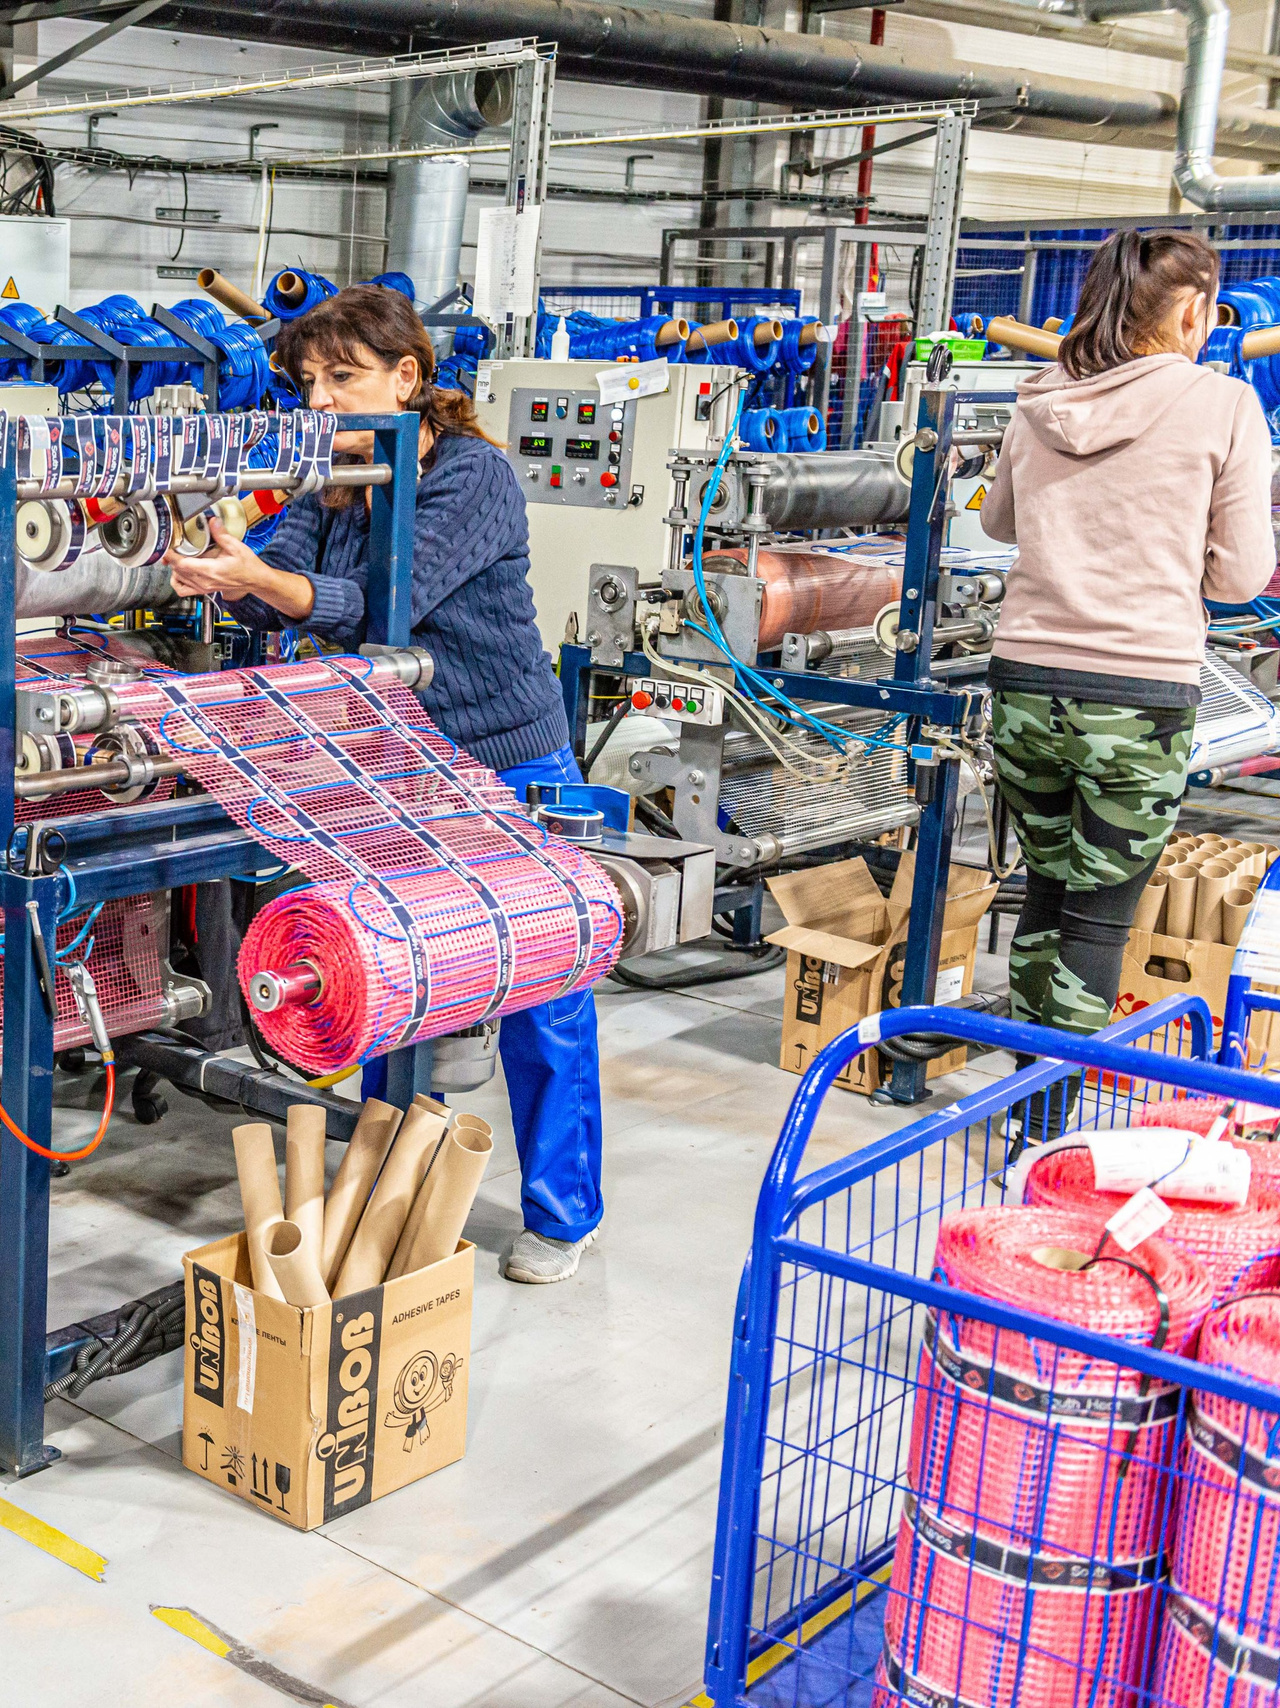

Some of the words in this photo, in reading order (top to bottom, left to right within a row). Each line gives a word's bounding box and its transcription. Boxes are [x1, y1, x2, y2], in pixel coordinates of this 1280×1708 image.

[140, 425, 148, 450] South
[51, 445, 59, 471] South
[111, 447, 119, 472] South
[500, 961, 508, 986] South
[391, 1300, 434, 1326] ADHESIVE
[435, 1288, 461, 1307] TAPES
[262, 1331, 287, 1347] ЛЕНТЫ
